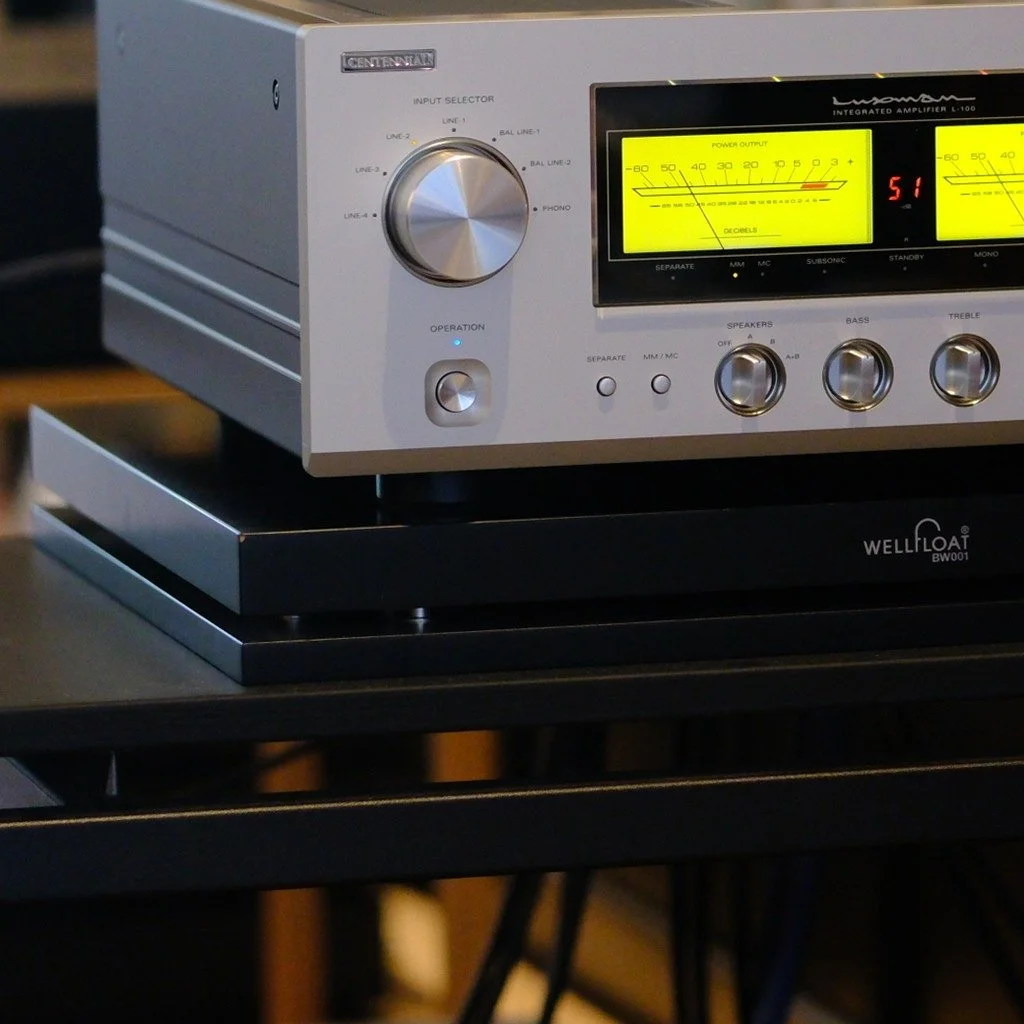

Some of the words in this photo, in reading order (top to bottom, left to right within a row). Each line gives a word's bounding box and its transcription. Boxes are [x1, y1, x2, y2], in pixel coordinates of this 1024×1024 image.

[347, 52, 431, 68] CENTENNIAL
[413, 97, 442, 105] INPUT
[445, 95, 495, 104] SELECTOR
[832, 108, 892, 116] INTEGRATED
[896, 106, 947, 114] AMPLIFIER
[970, 152, 986, 160] 50
[1000, 151, 1016, 159] 40
[660, 164, 676, 172] 50
[691, 163, 707, 171] 40
[717, 162, 733, 170] 30
[743, 161, 759, 169] 20
[774, 160, 785, 168] 10
[812, 159, 821, 167] 0
[831, 158, 839, 166] 3
[888, 176, 922, 201] 51
[806, 257, 846, 265] SUBSONIC
[888, 254, 925, 262] STANDBY
[655, 263, 695, 271] SEPARATE
[948, 312, 981, 320] TREBLE
[430, 323, 485, 333] OPERATION
[726, 321, 774, 330] SPEAKERS
[586, 353, 627, 363] SEPARATE
[665, 352, 679, 360] MC
[932, 552, 970, 563] BW001
